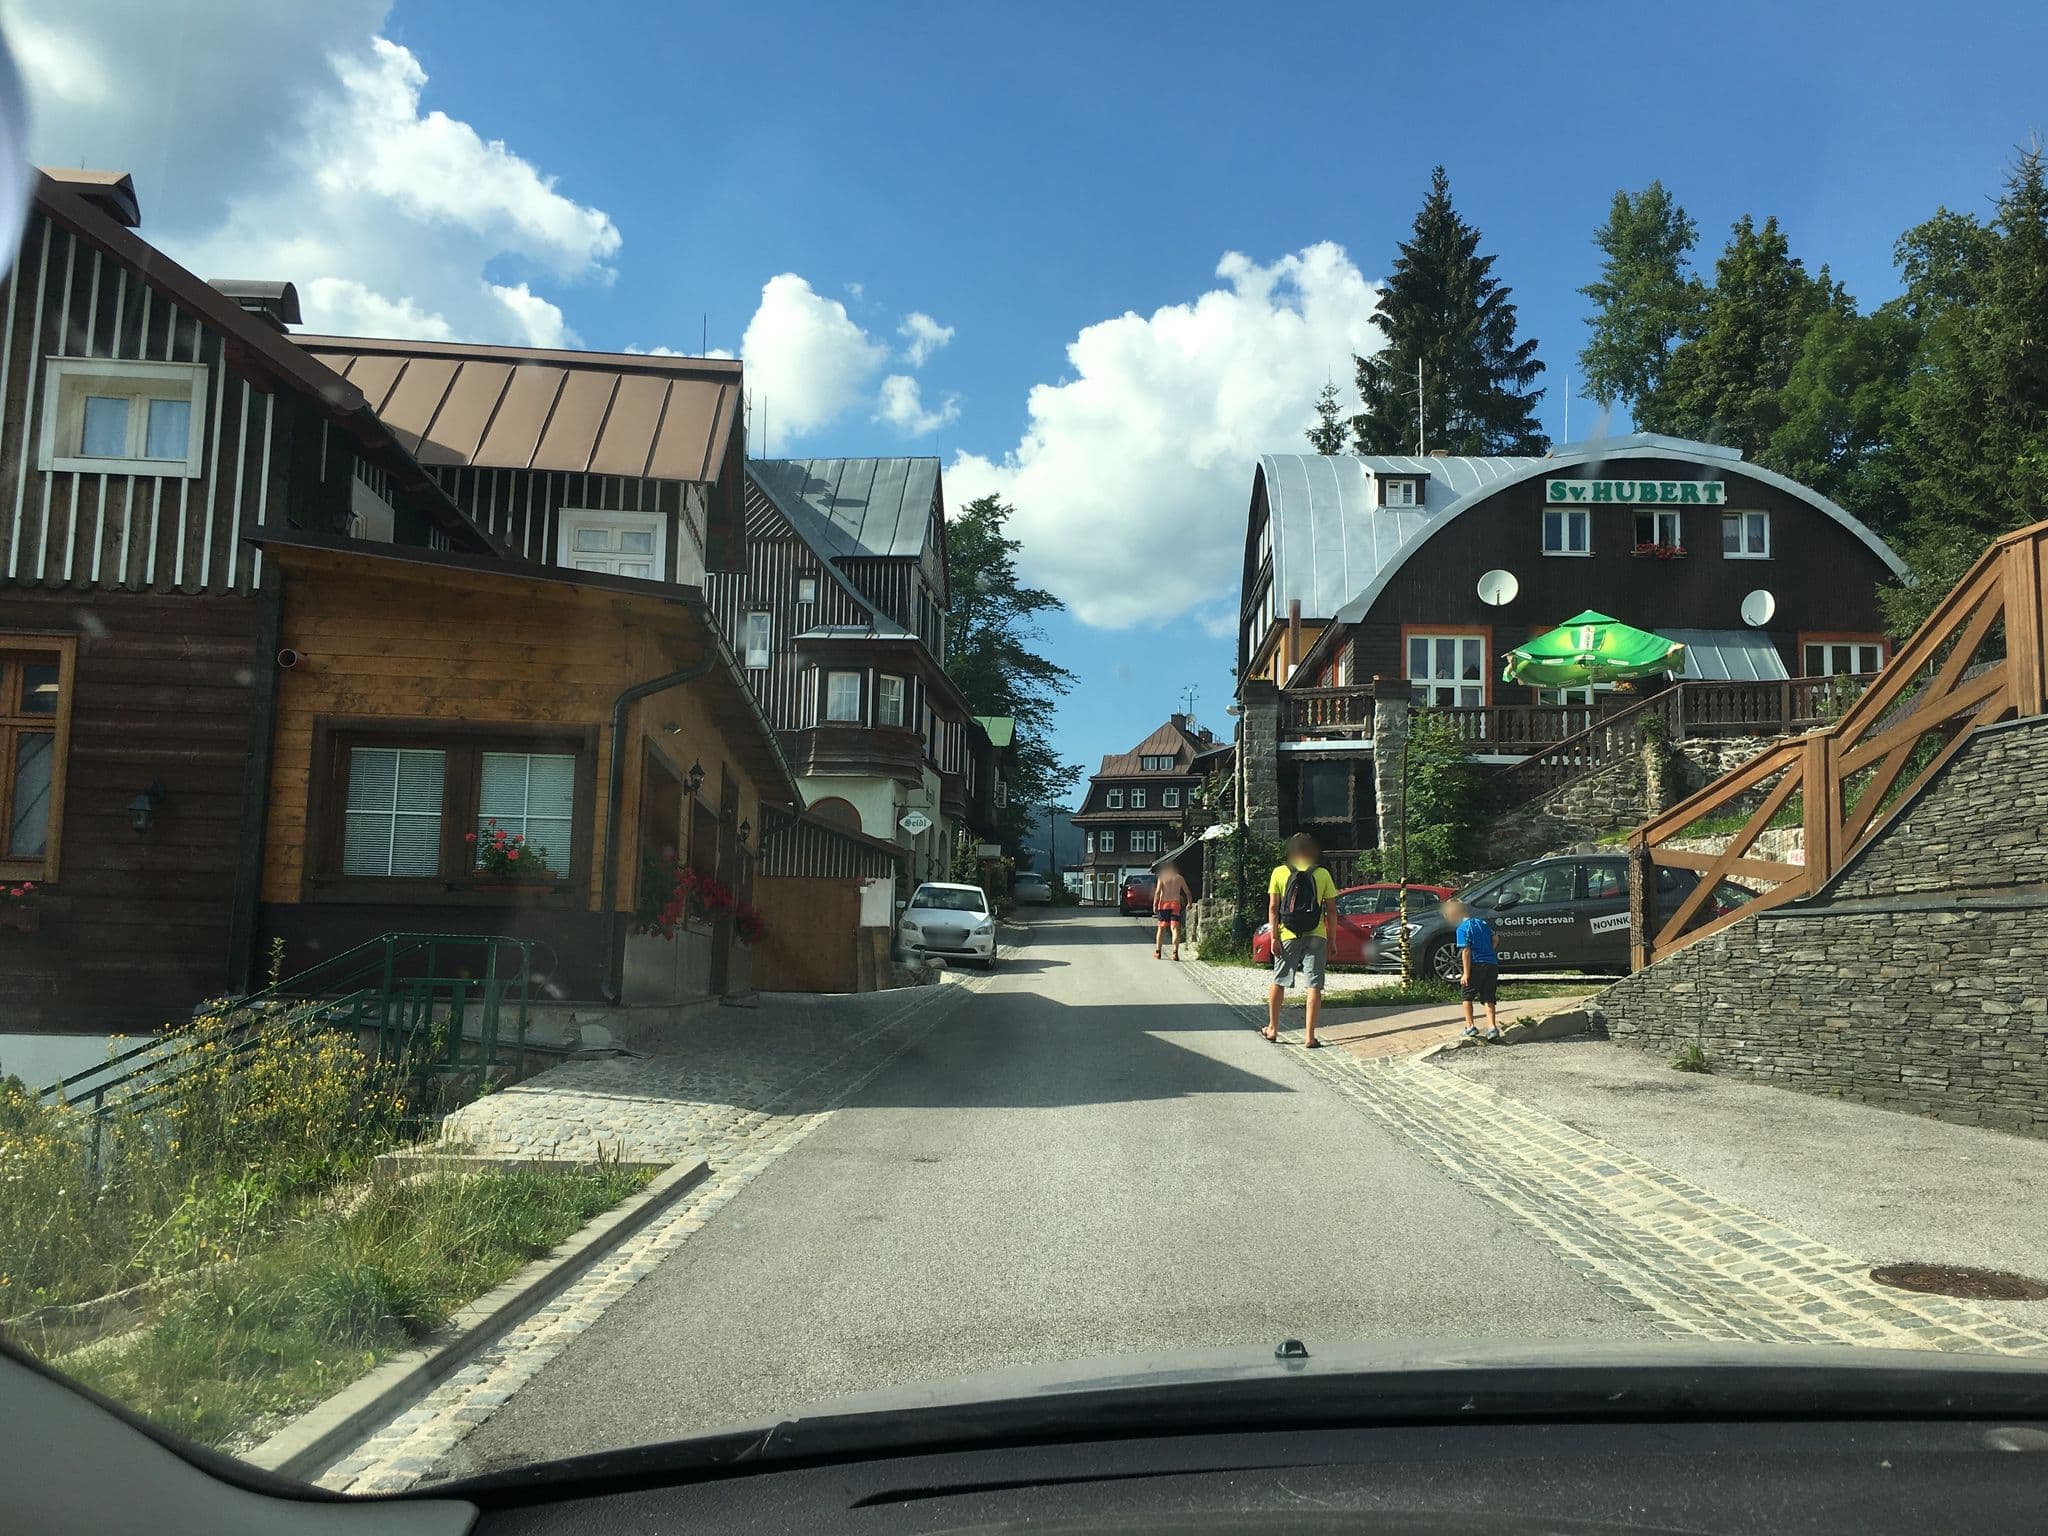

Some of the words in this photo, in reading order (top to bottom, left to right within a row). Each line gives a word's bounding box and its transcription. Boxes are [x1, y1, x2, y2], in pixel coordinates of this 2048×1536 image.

[1550, 481, 1586, 500] Sv.
[1591, 481, 1722, 503] HUBERT
[1504, 917, 1524, 926] Golf
[1526, 916, 1574, 926] Sportsvan
[1593, 916, 1630, 930] NOVINK
[1497, 951, 1510, 960] CB
[1512, 951, 1537, 960] Auto
[1539, 951, 1557, 959] a.s.
